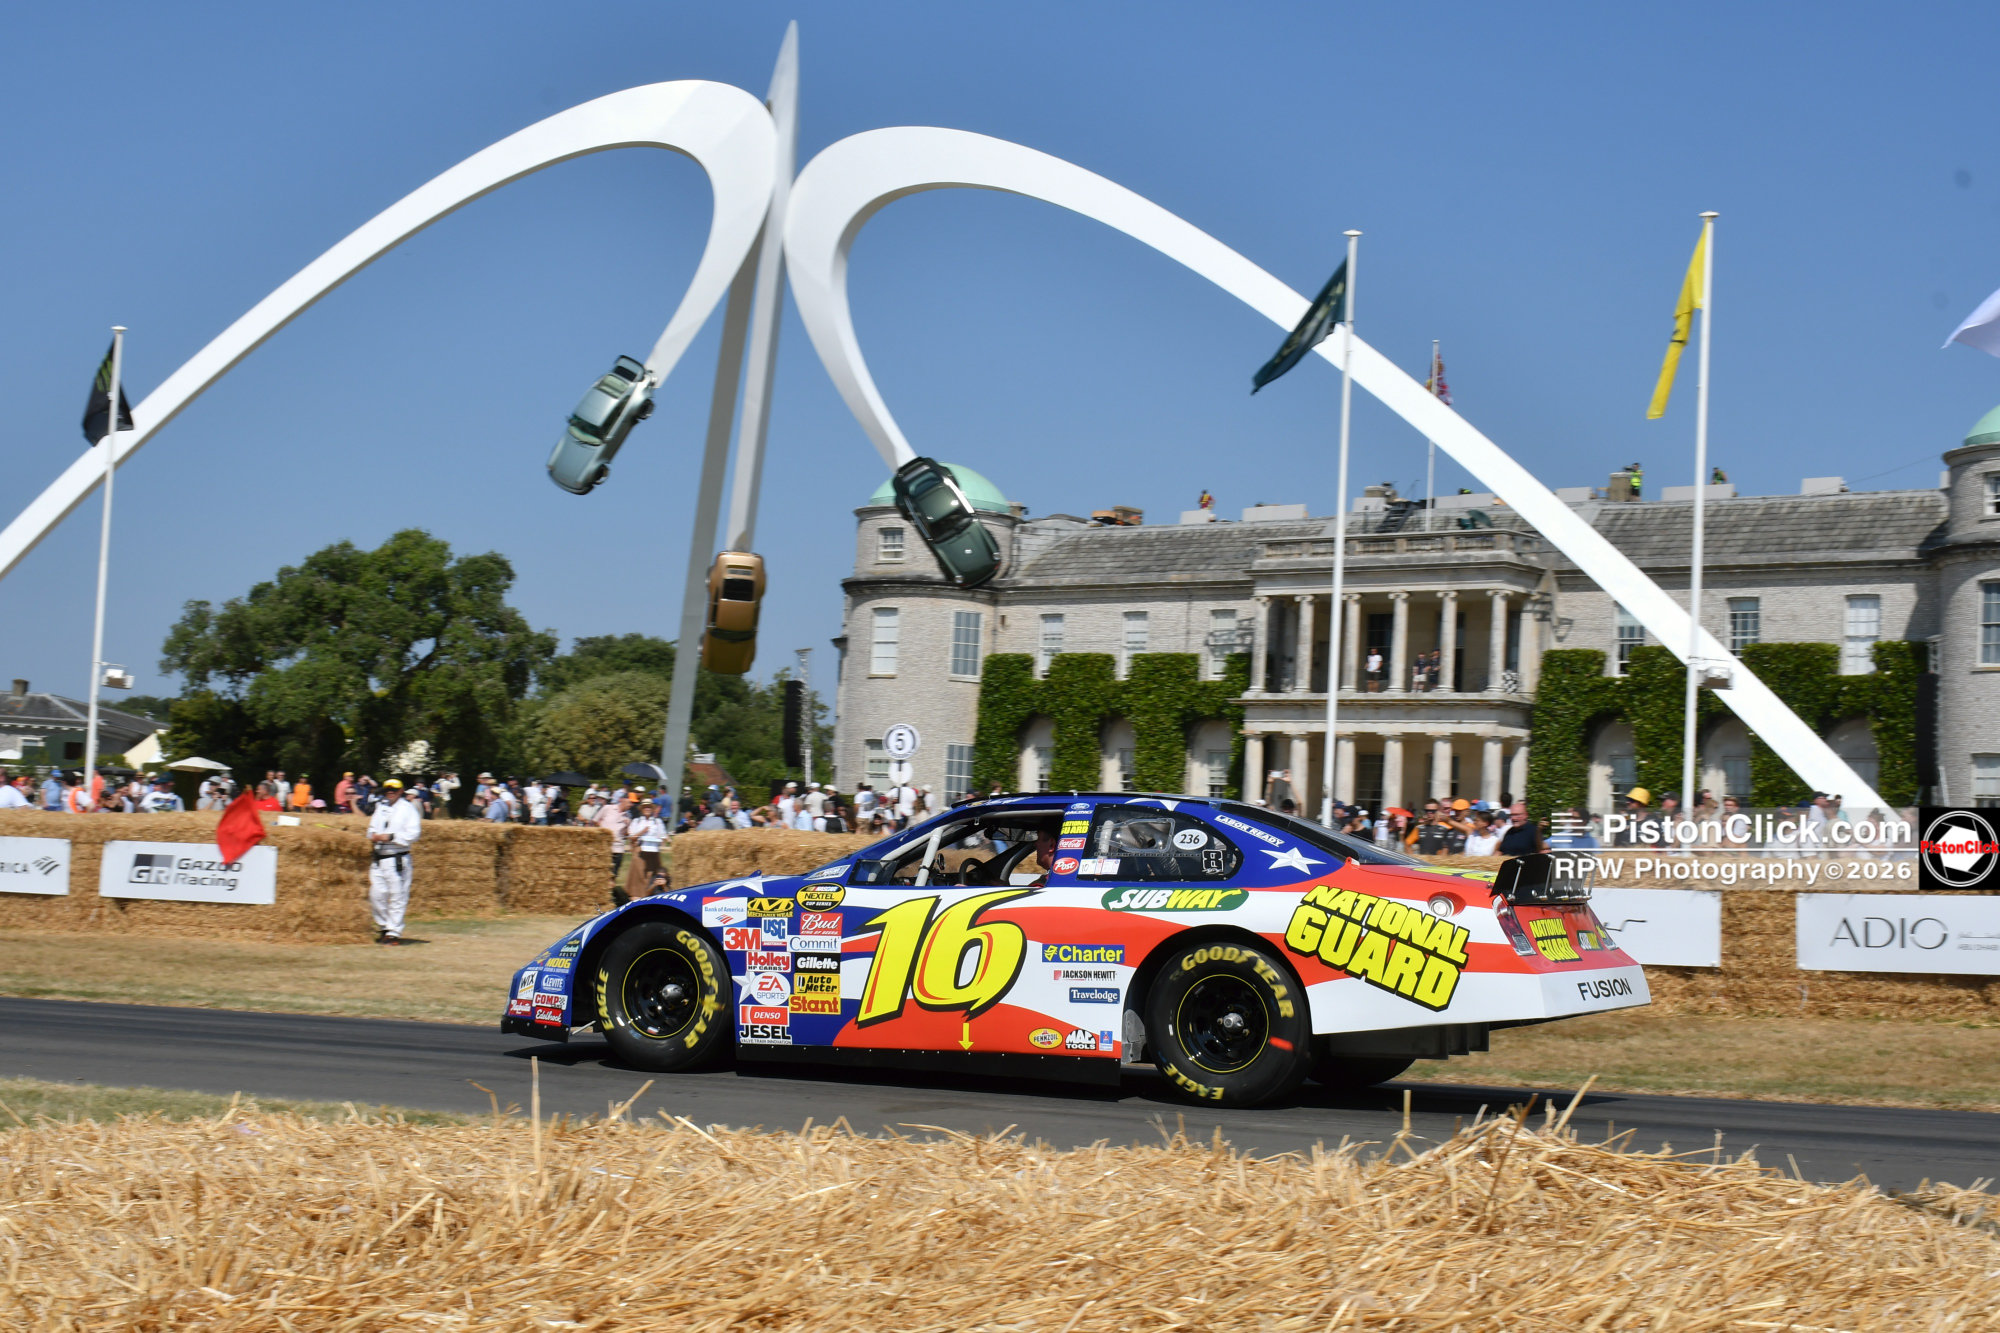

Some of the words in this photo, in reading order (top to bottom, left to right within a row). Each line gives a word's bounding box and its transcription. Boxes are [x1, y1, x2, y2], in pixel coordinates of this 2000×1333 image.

[895, 733, 905, 751] 5
[1179, 834, 1200, 845] 236
[1214, 815, 1250, 834] LABOR
[1250, 826, 1285, 847] READY
[1054, 861, 1076, 871] Post
[174, 872, 240, 891] Racing
[1108, 889, 1242, 910] SUBWAY
[763, 919, 786, 940] USG
[802, 914, 841, 930] Bud
[1300, 885, 1471, 969] NATIONAL
[1529, 918, 1567, 937] NATIONAL
[724, 928, 760, 950] 3M
[1830, 917, 1949, 950] ADIO
[790, 936, 838, 951] Commit
[748, 952, 790, 970] Holley
[855, 888, 1044, 1028] 16
[1059, 945, 1124, 962] Charter
[1284, 904, 1461, 1012] GUARD
[545, 958, 572, 968] MOOG
[797, 957, 838, 969] Gillette
[521, 972, 536, 989] WIX
[758, 975, 784, 991] EA
[807, 976, 832, 984] Auto
[1063, 970, 1093, 979] JACKSON
[1094, 970, 1116, 979] HEWITT
[1181, 946, 1295, 1018] GOODYEAR
[676, 930, 719, 1049] GOODYEAR
[757, 992, 785, 1000] SPORTS
[806, 984, 837, 992] Meter
[1071, 989, 1118, 1003] Travelodge
[1577, 978, 1632, 1001] FUSION
[535, 994, 559, 1004] COMP
[597, 968, 615, 1031] EAGLE
[790, 996, 839, 1013] Stant
[536, 1009, 562, 1022] Edelbrock
[754, 1012, 781, 1020] DENSO
[741, 1025, 791, 1040] JESEL
[1033, 1033, 1059, 1043] PENNZOIL
[1163, 1063, 1225, 1100] EAGLE
